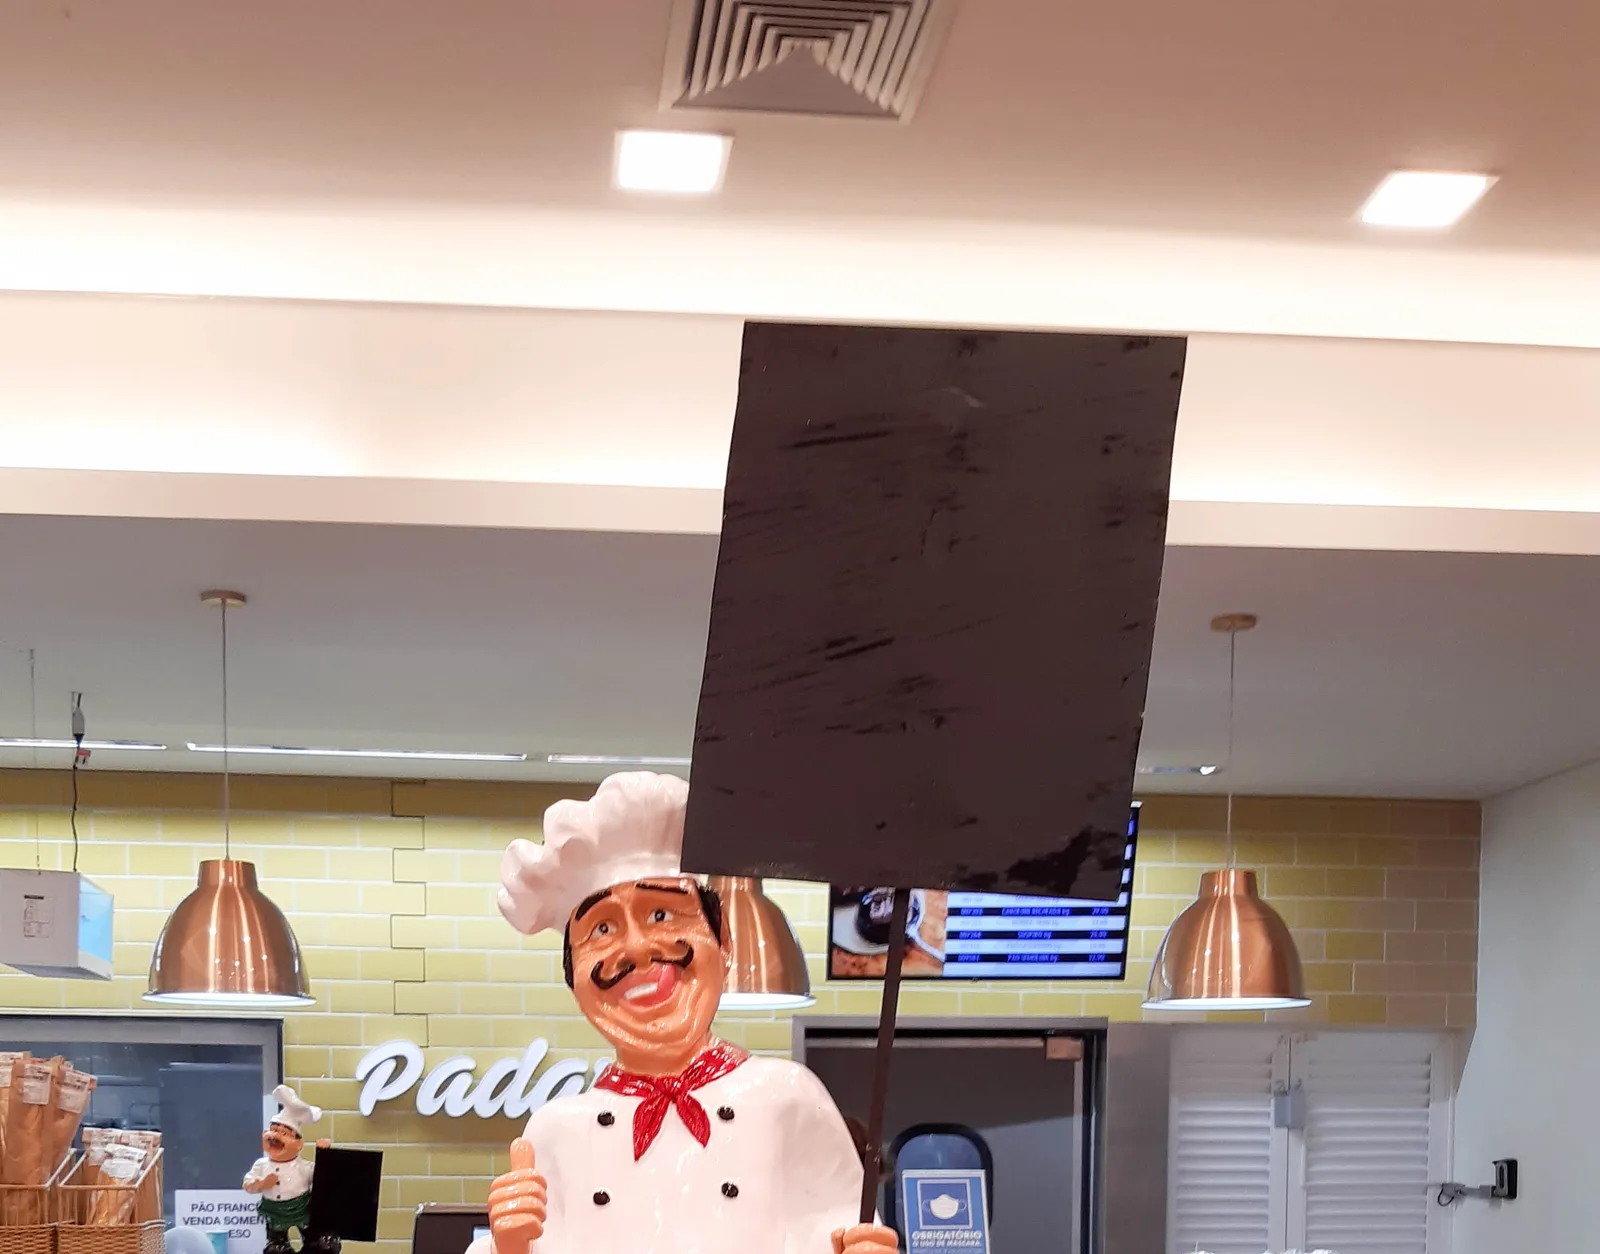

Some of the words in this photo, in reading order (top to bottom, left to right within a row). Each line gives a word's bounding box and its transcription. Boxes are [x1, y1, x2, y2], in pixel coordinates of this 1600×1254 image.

[355, 1037, 612, 1119] Pada
[190, 1201, 215, 1213] PÃO
[182, 1216, 221, 1226] VENDA
[223, 1216, 265, 1226] SOMEN
[227, 1228, 252, 1239] ESO
[912, 1229, 982, 1240] OBRIGATÓRIO
